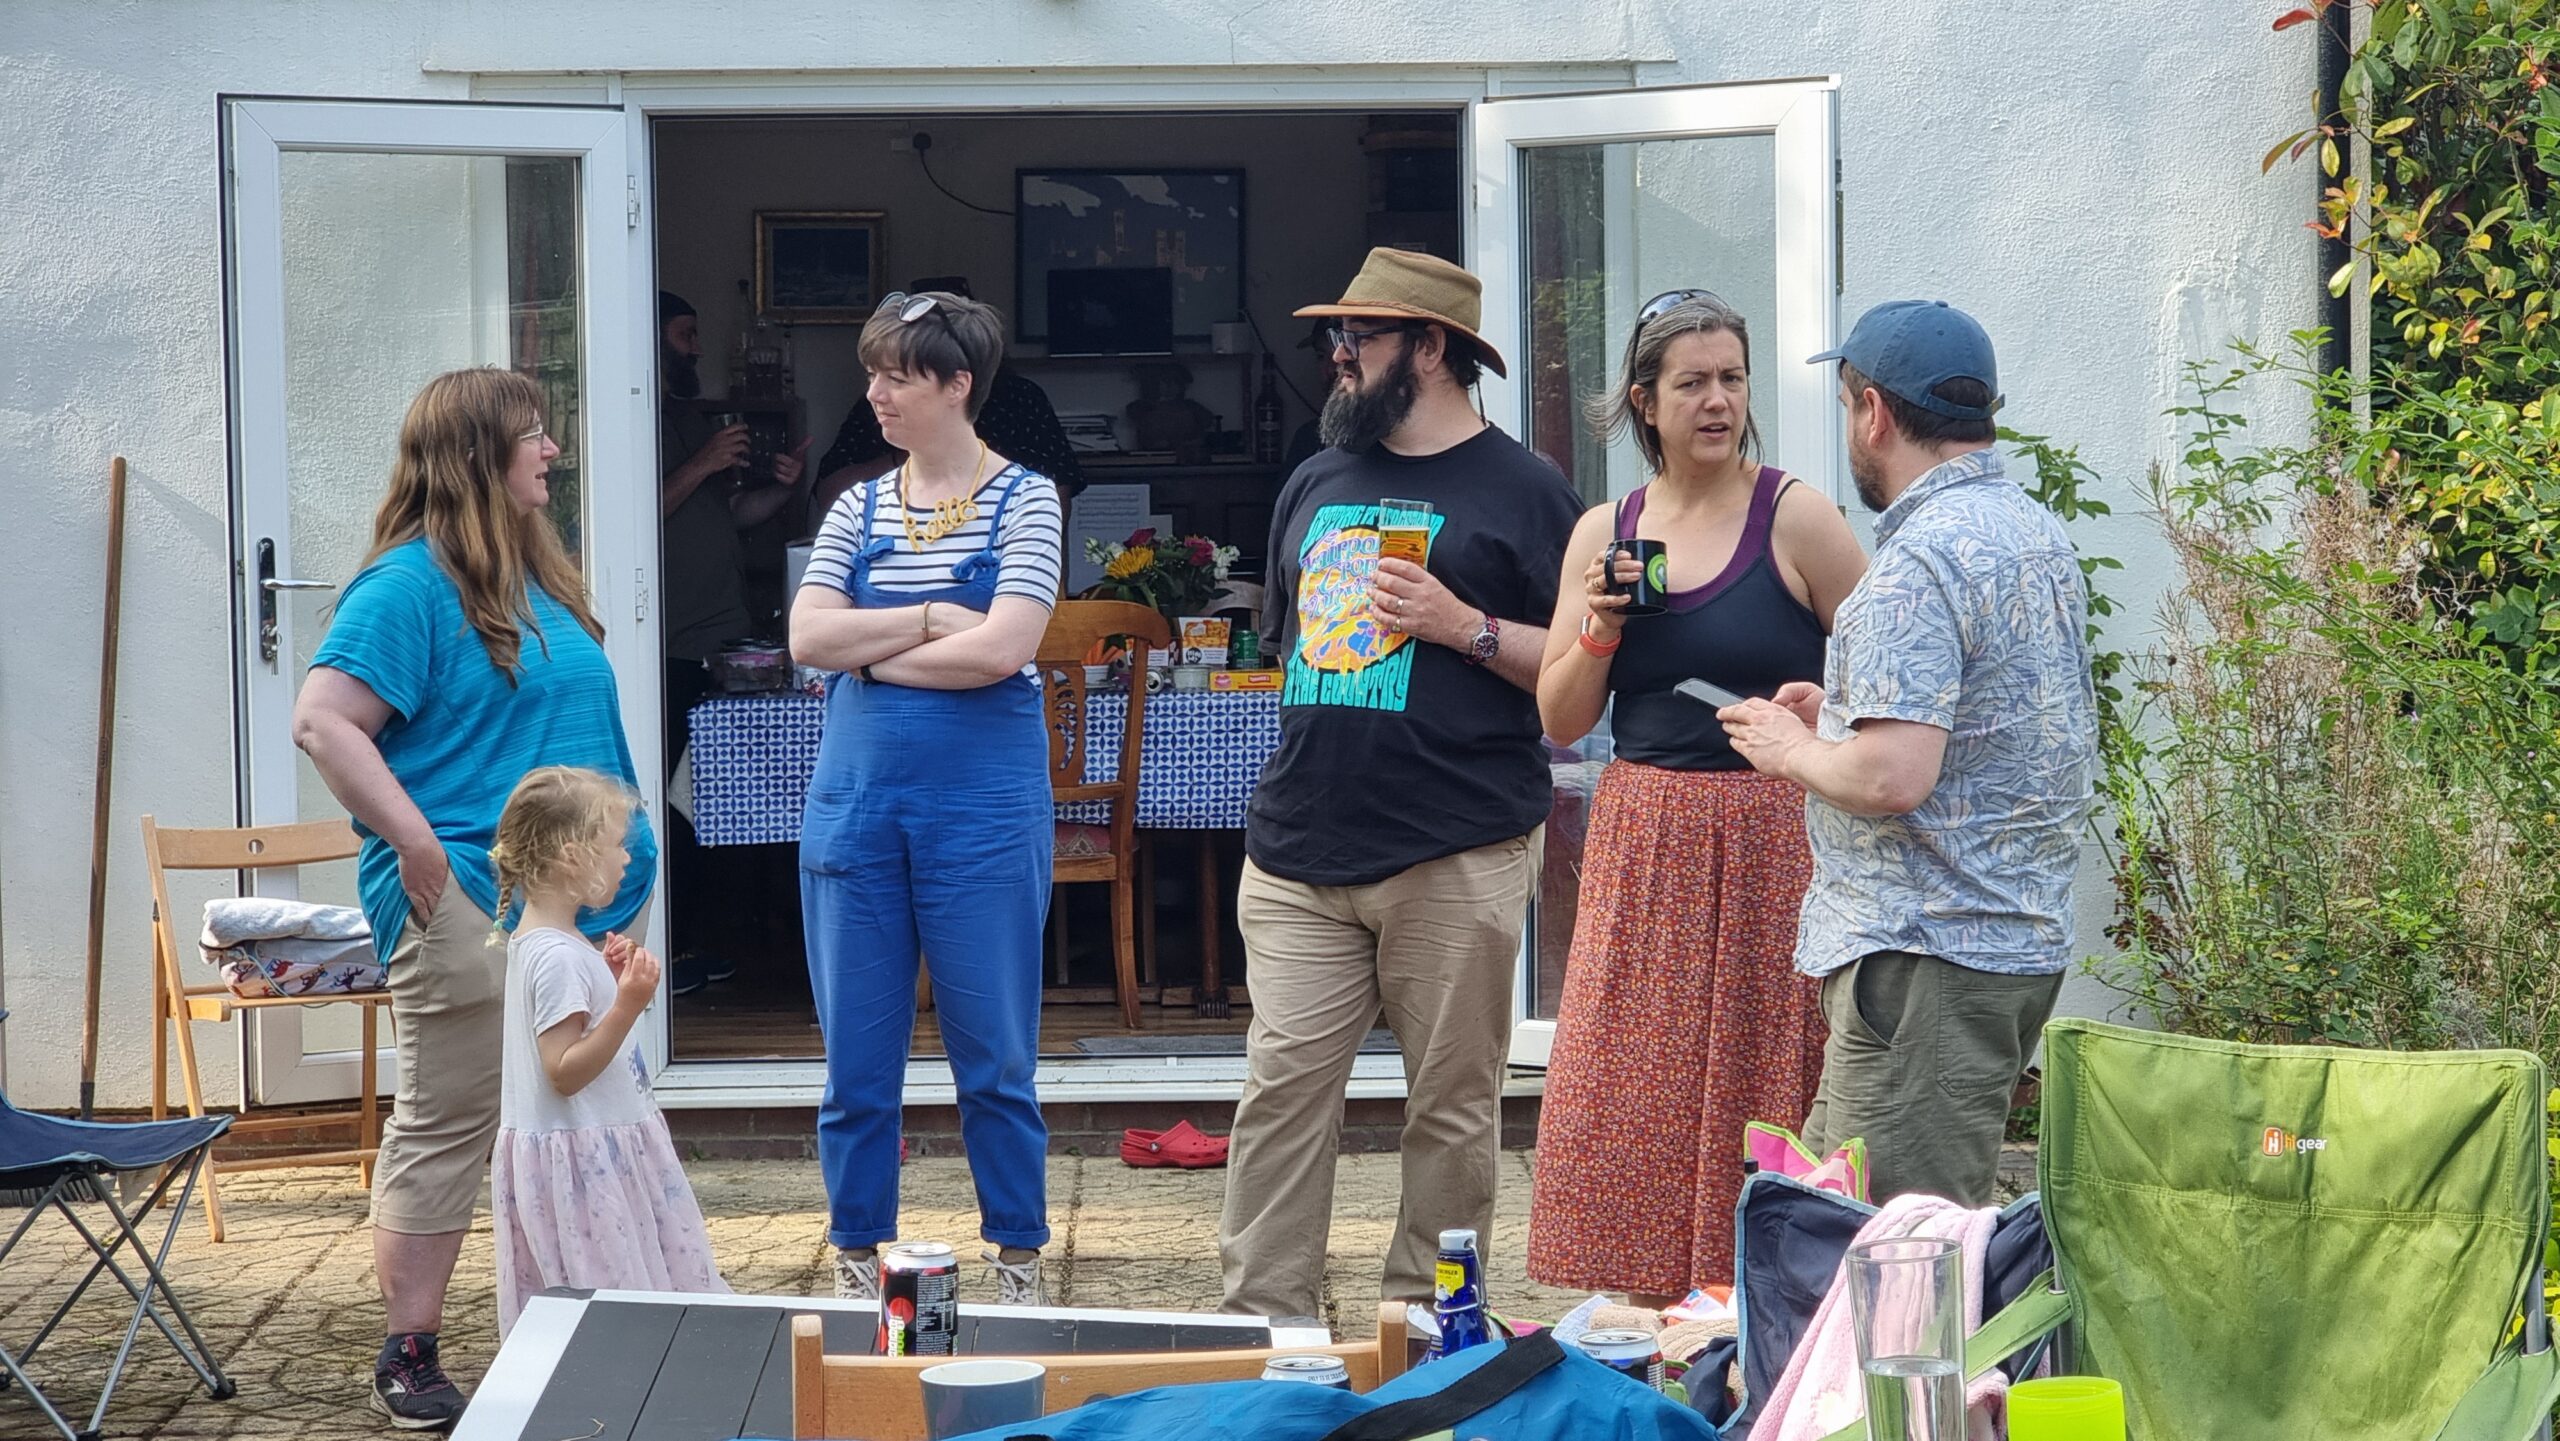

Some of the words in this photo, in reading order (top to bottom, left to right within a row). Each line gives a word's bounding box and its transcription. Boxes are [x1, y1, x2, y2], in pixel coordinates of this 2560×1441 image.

[905, 496, 980, 554] hello
[1298, 528, 1379, 573] Fairpo
[1318, 559, 1380, 595] Crop
[1293, 657, 1320, 705] THE
[1319, 638, 1417, 712] COUNTRY
